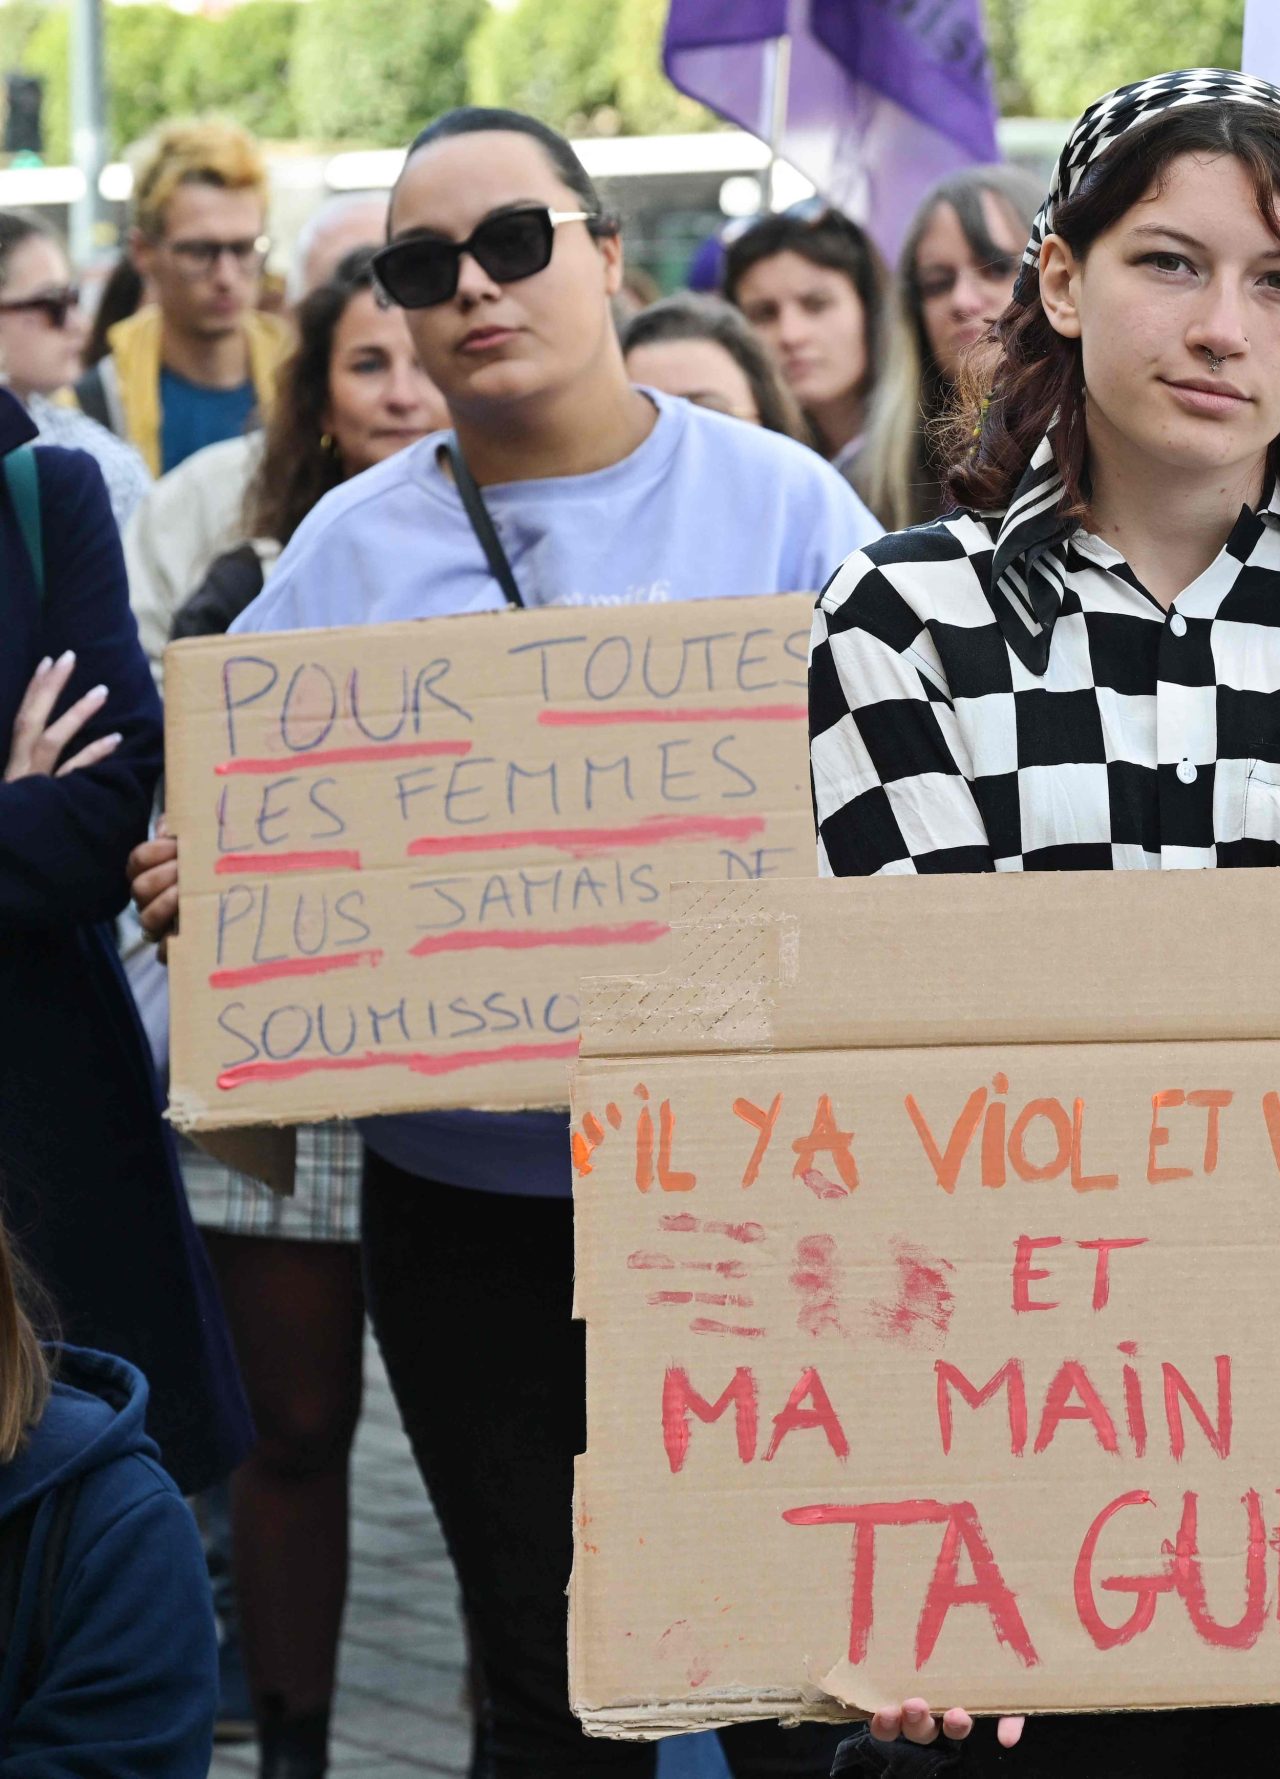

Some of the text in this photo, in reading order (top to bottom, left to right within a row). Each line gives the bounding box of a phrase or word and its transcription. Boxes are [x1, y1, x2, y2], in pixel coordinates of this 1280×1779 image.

[222, 657, 474, 755] POUR
[216, 735, 758, 853] LES FEMMES
[216, 884, 371, 965] PLUS
[408, 862, 662, 930] JAMAIS
[1147, 1088, 1235, 1184] ET
[1011, 1234, 1149, 1315] ET
[662, 1361, 850, 1473] MA
[782, 1498, 1040, 1672] TA
